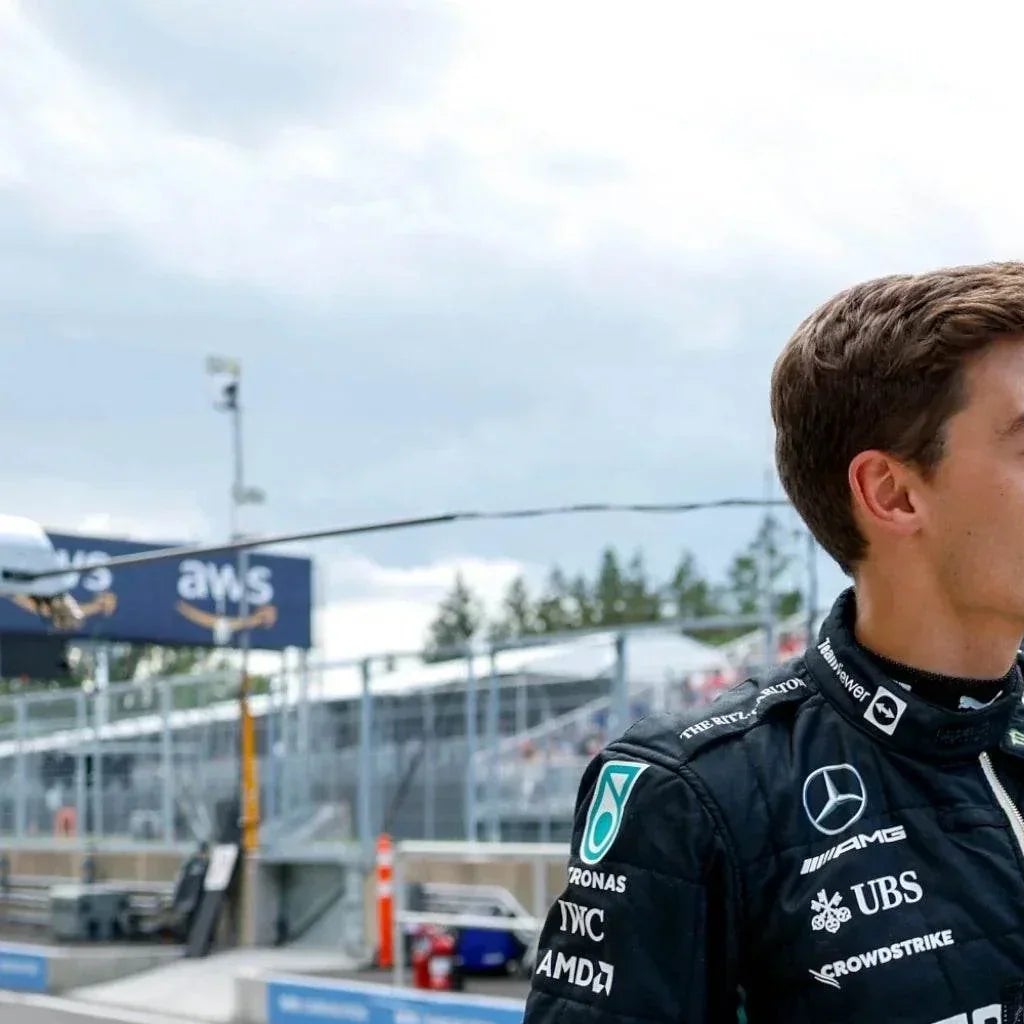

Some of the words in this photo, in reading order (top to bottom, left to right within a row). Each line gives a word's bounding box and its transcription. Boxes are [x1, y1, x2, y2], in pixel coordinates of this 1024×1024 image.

[177, 558, 275, 605] aws
[817, 636, 872, 703] Teamiewer
[679, 720, 714, 741] THE
[850, 870, 924, 916] UBS
[558, 899, 605, 942] IWC
[536, 949, 594, 988] AMD
[820, 929, 956, 980] CROWDSTRIKE
